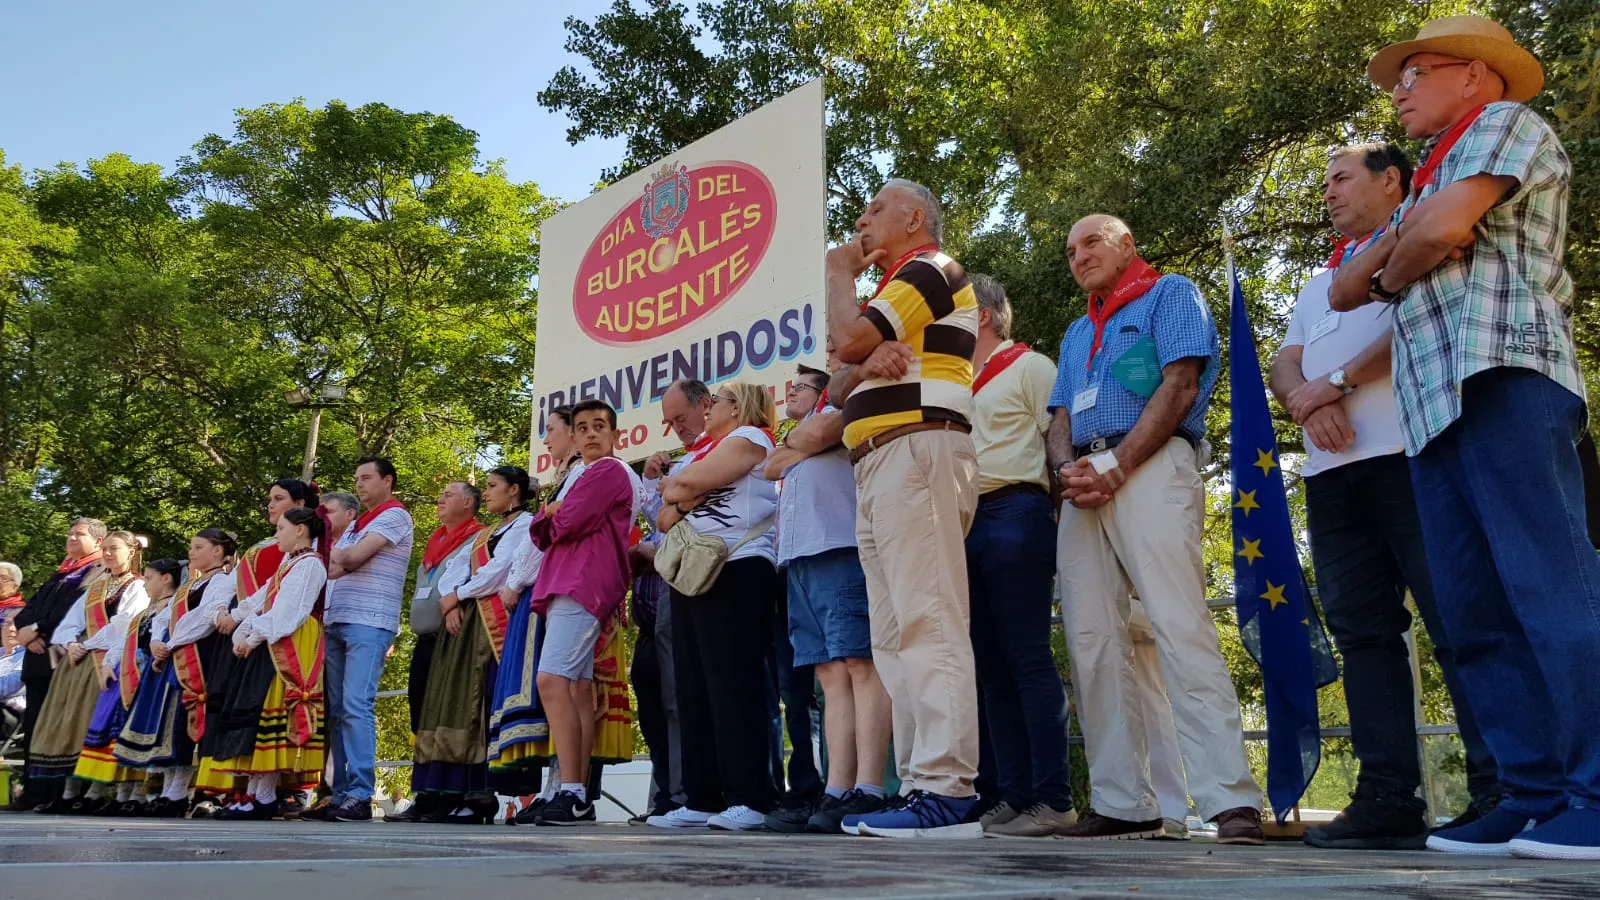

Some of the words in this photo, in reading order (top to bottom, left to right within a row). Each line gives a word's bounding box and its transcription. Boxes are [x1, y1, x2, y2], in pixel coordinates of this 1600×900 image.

[587, 203, 762, 296] BURGALÉS
[601, 216, 636, 256] DÍA
[698, 174, 746, 202] DEL
[595, 244, 750, 333] AUSENTE
